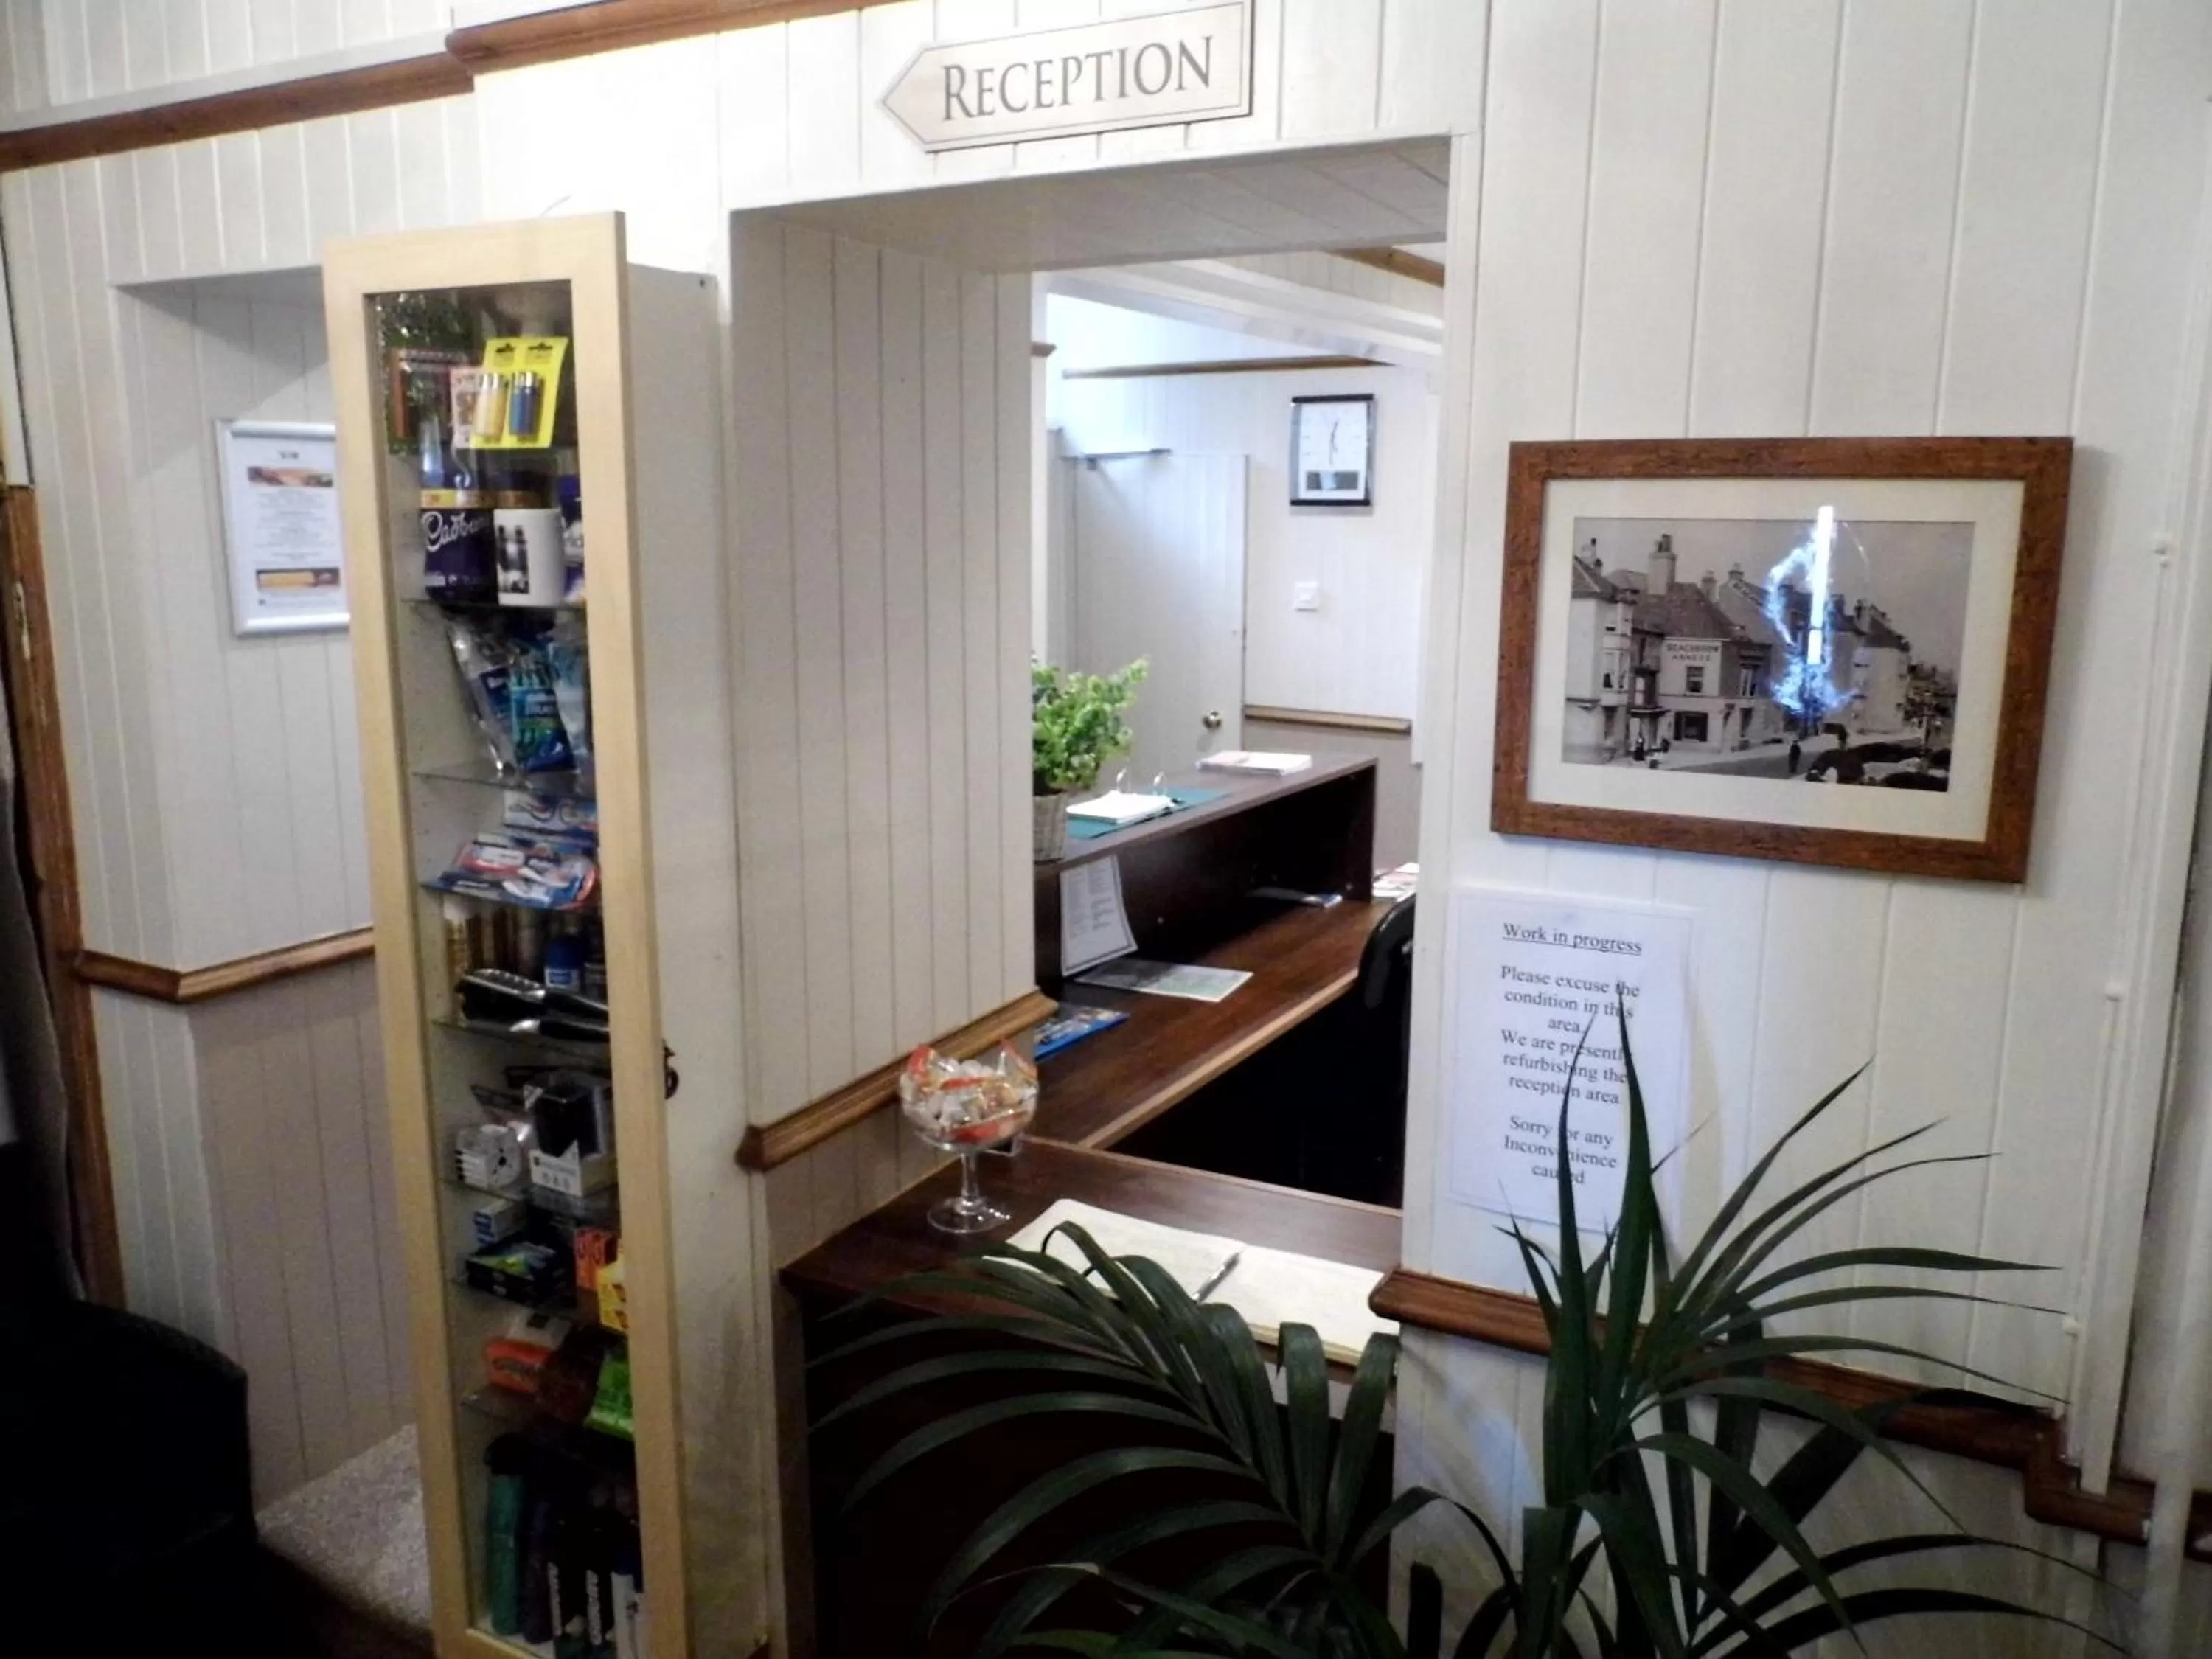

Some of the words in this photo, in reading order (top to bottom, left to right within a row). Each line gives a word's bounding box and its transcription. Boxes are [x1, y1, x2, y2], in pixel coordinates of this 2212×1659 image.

[942, 35, 1213, 121] RECEPTION
[1503, 922, 1546, 940] Work
[1554, 928, 1568, 943] in
[1573, 934, 1642, 953] progress
[1501, 965, 1551, 985] Please
[1555, 976, 1610, 993] excuse
[1616, 979, 1640, 997] the
[1504, 991, 1578, 1010] condition
[1584, 998, 1598, 1015] in
[1604, 1002, 1634, 1018] ths
[1502, 1029, 1527, 1046] We
[1531, 1037, 1555, 1051] are
[1560, 1042, 1624, 1060] presentl
[1604, 1067, 1627, 1083] the
[1509, 1115, 1553, 1140] Sorry
[1585, 1133, 1613, 1150] any
[1504, 1135, 1617, 1169] Inconvnience
[1531, 1166, 1585, 1185] caud
